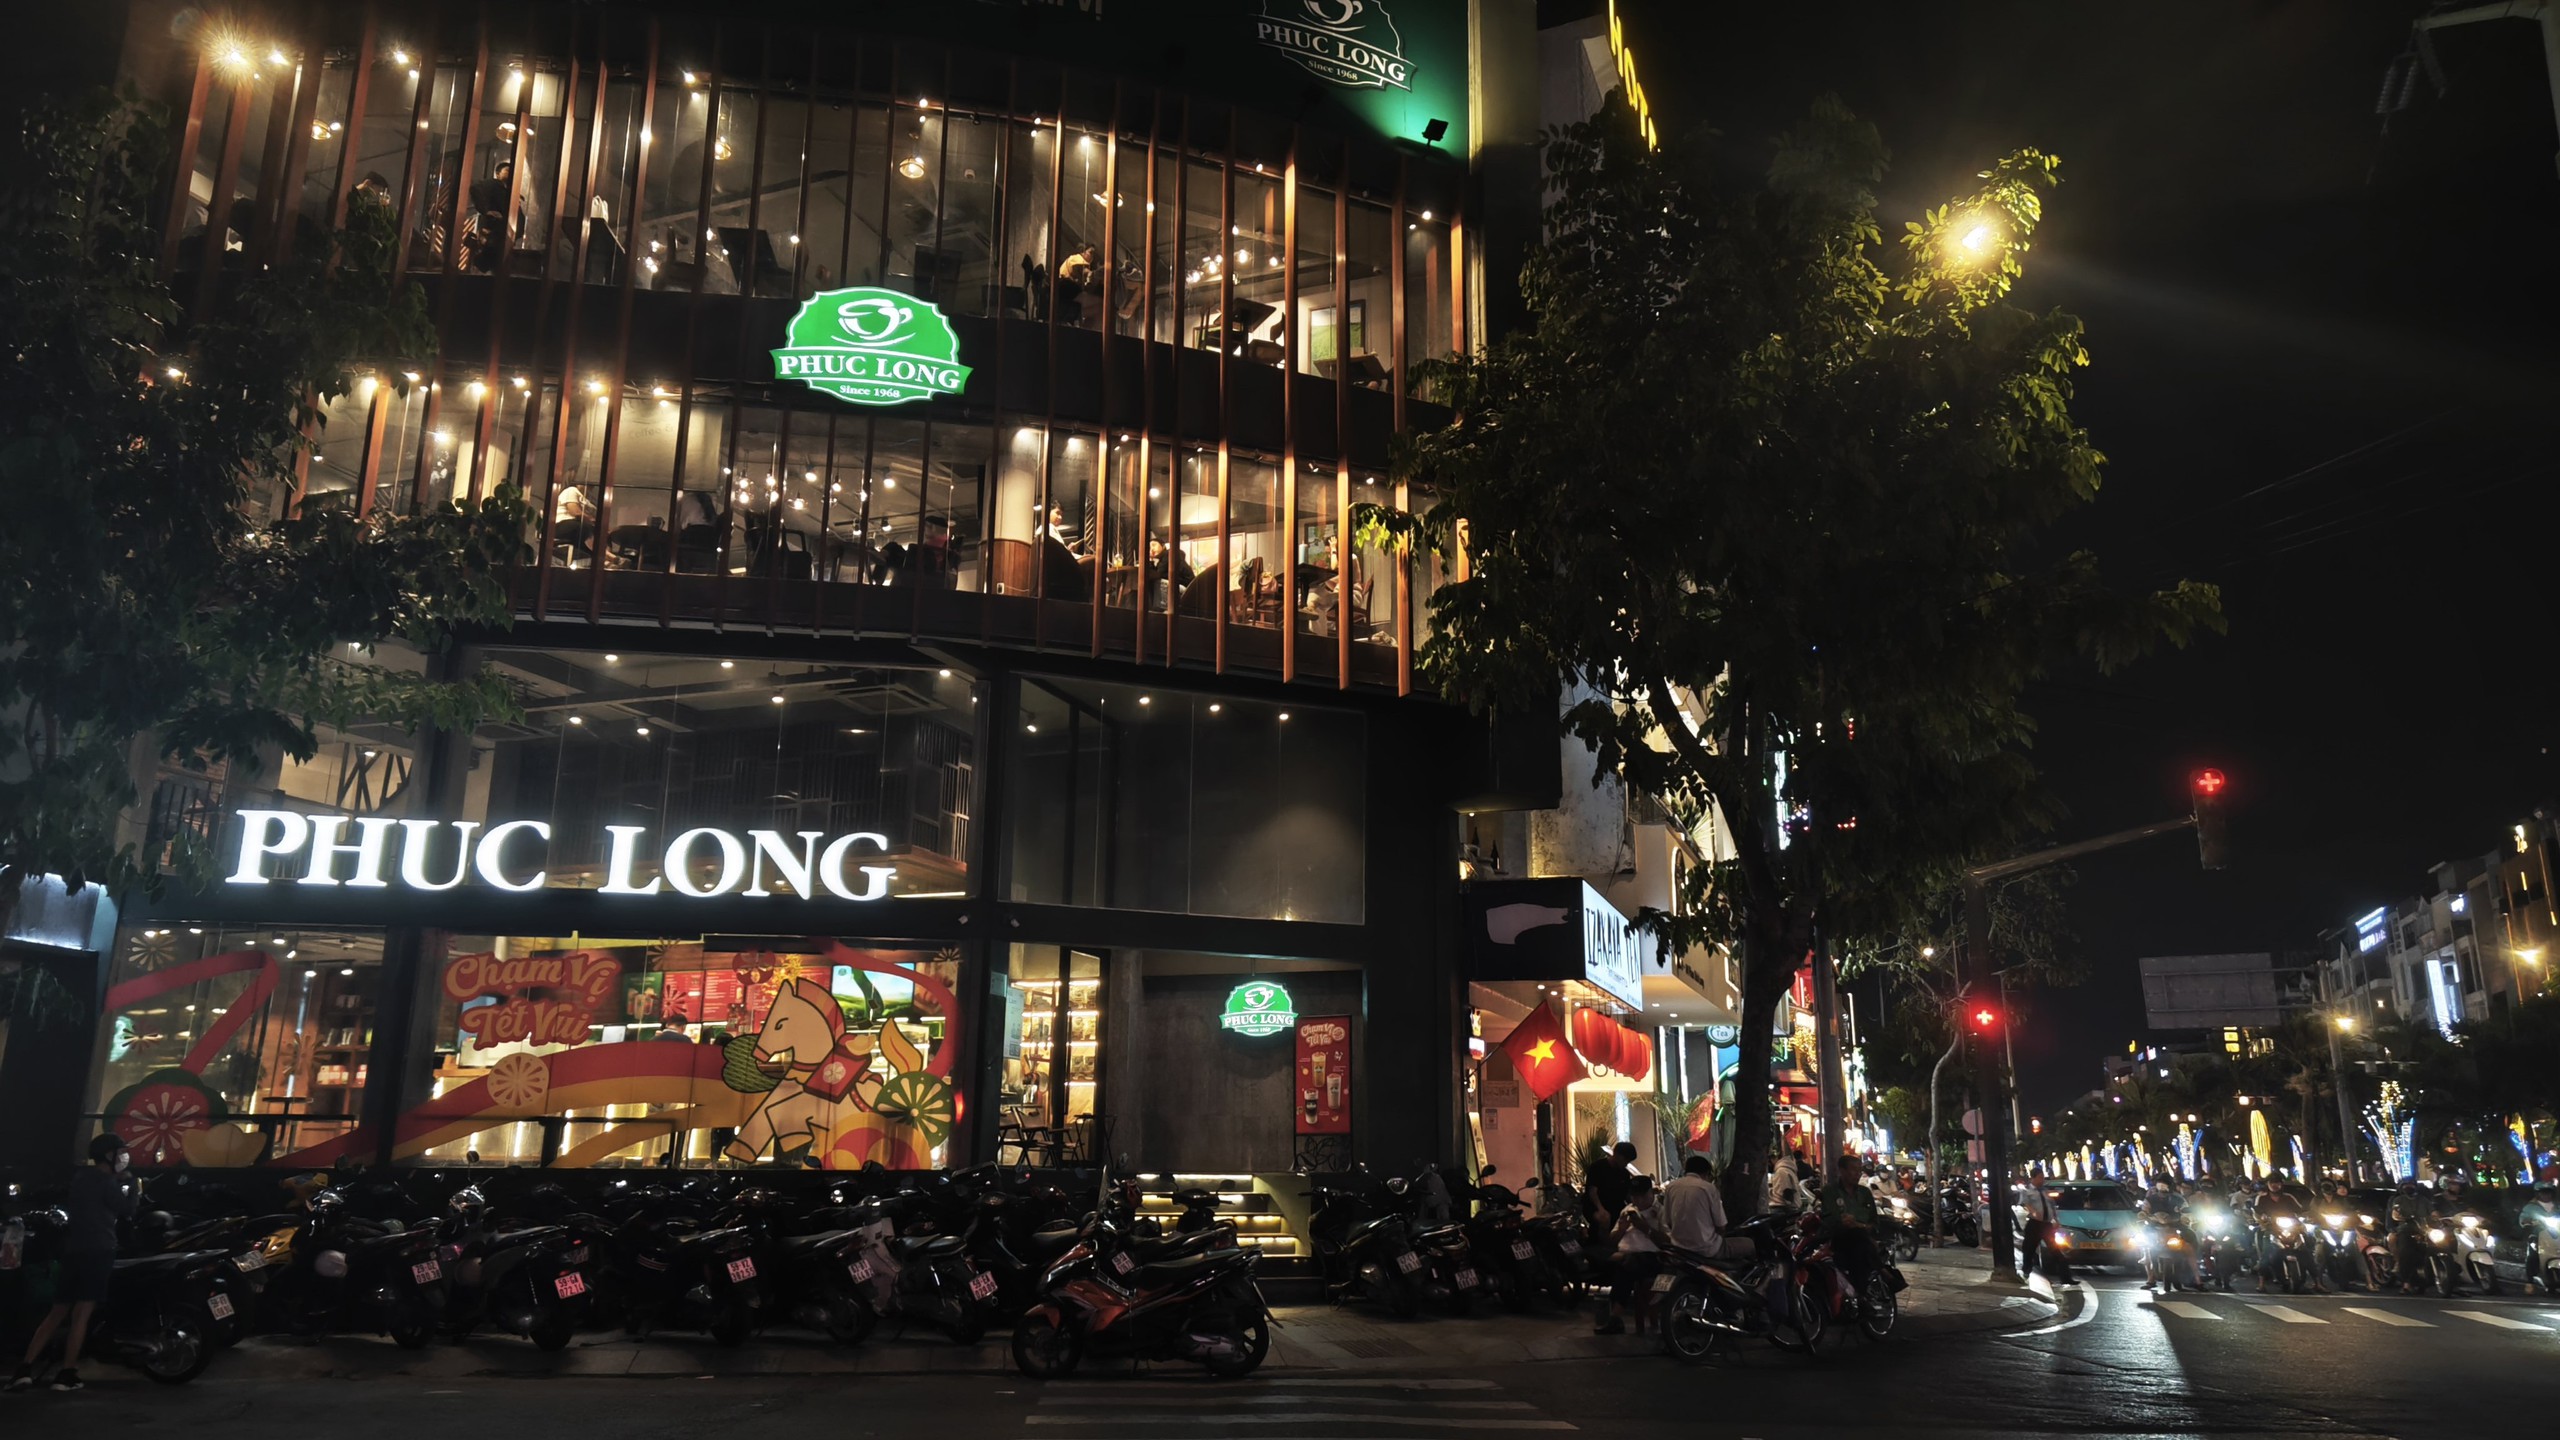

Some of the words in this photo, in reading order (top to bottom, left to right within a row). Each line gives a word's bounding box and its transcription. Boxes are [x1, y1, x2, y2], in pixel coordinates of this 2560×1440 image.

[1257, 22, 1330, 54] PHUC
[1337, 41, 1407, 82] LONG
[1308, 60, 1334, 74] Since
[1336, 67, 1358, 80] 1968
[778, 354, 867, 376] PHUC
[874, 357, 961, 389] LONG
[839, 384, 871, 396] Since
[874, 387, 900, 398] 1968
[225, 808, 551, 892] PHUC
[597, 824, 897, 902] LONG
[1585, 907, 1622, 969] IZAKAYA
[445, 954, 566, 999] Chạm
[569, 958, 618, 1003] Vị
[463, 999, 529, 1047] Tết
[533, 1002, 590, 1042] Vui
[1224, 1013, 1258, 1026] PHUC
[1259, 1012, 1294, 1026] LONG
